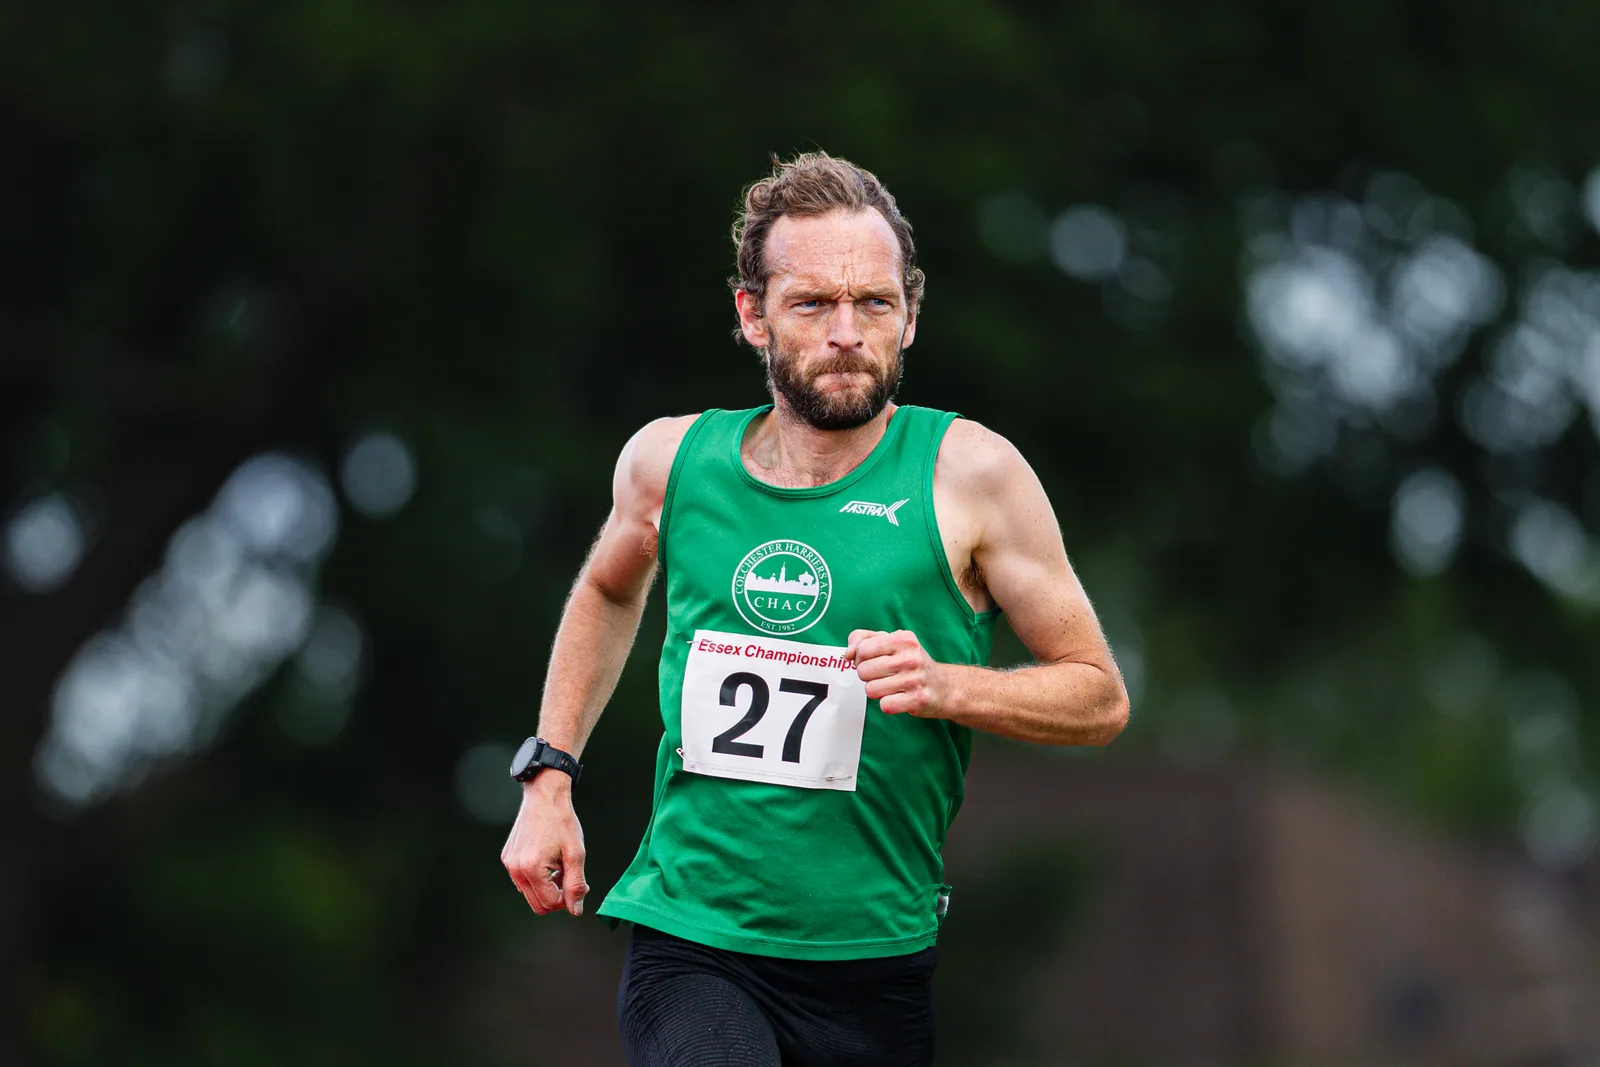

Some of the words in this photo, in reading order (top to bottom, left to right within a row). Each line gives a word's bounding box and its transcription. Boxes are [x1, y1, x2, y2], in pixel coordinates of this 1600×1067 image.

[735, 543, 782, 595] COLCHESTER
[785, 542, 828, 579] HARRIERS
[698, 639, 741, 656] Essex
[712, 671, 829, 763] 27
